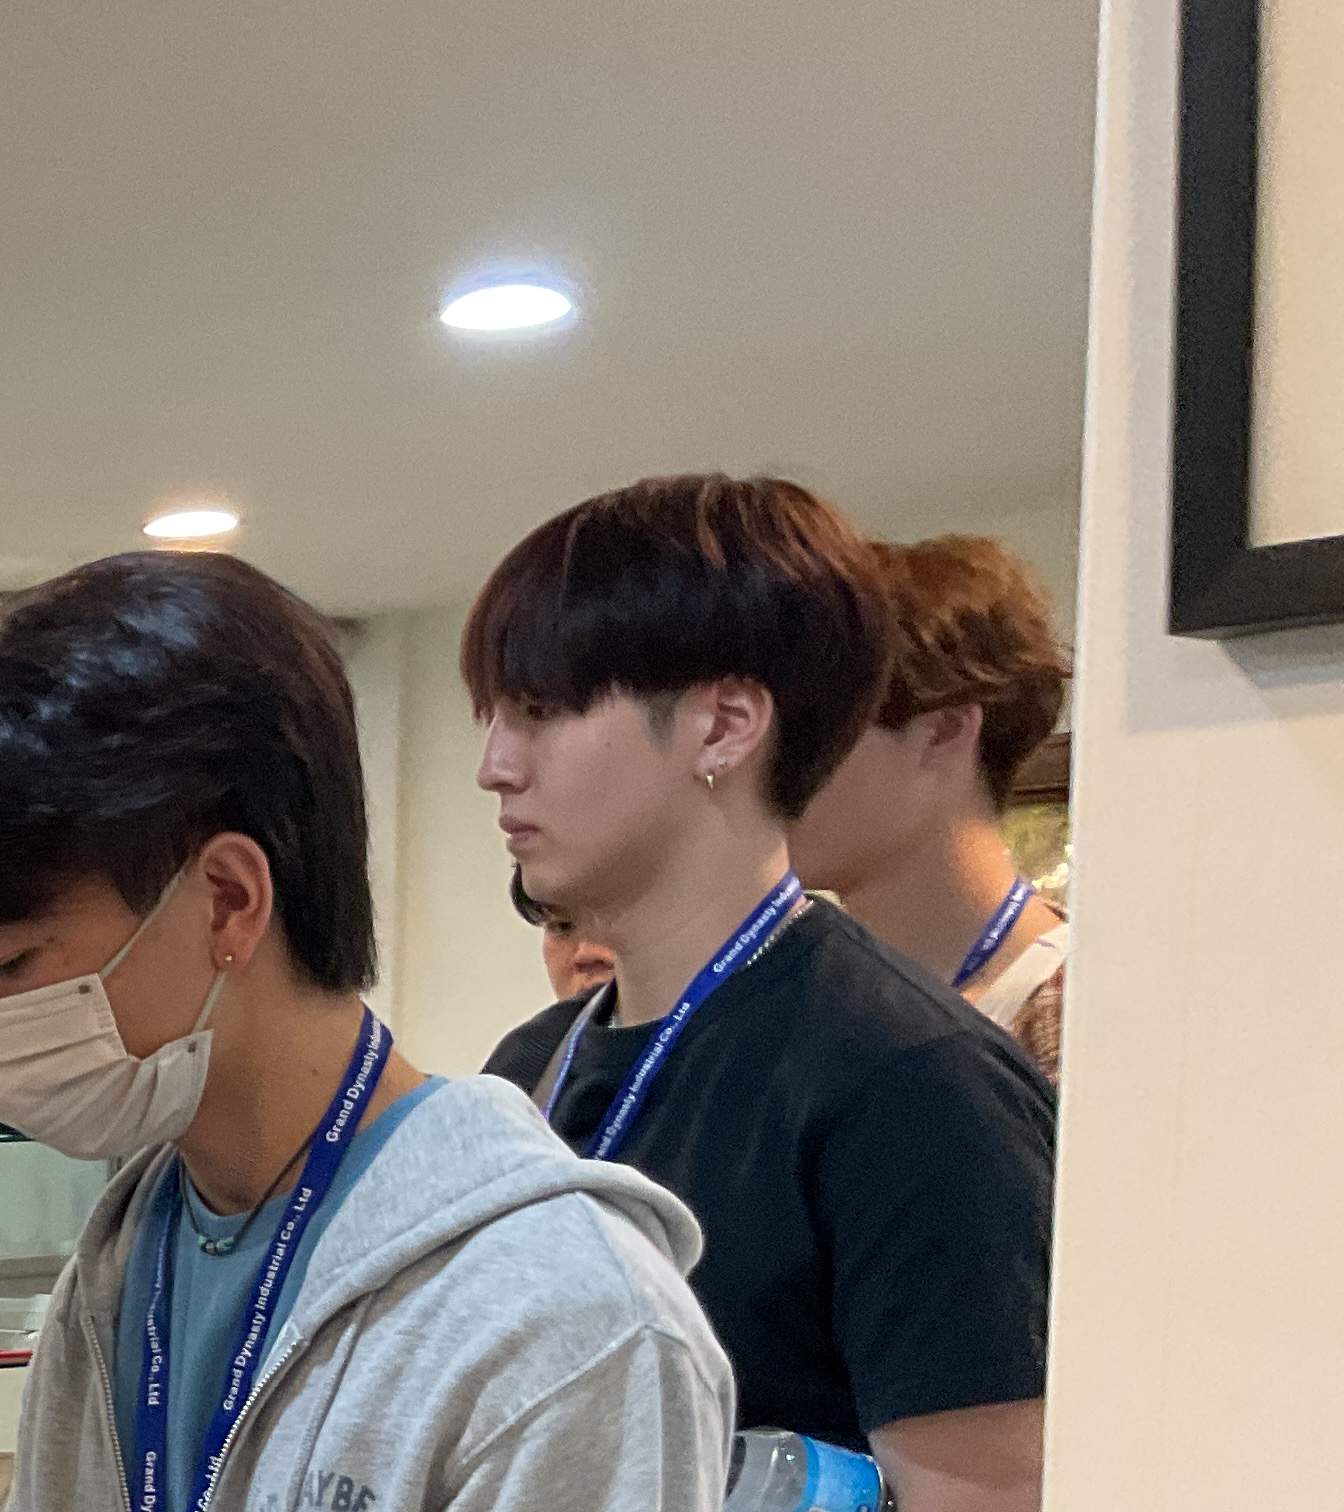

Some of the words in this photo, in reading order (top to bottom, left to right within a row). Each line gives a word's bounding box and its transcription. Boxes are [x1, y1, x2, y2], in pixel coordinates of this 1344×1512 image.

[326, 1100, 354, 1142] Grand
[347, 1046, 379, 1099] Dynasty
[223, 1367, 243, 1411] Grand
[235, 1311, 266, 1367] Dynasty
[255, 1242, 288, 1310] Industrial
[295, 1187, 313, 1212] Ltd
[147, 1383, 160, 1406] Ltd
[143, 1451, 156, 1493] Grand
